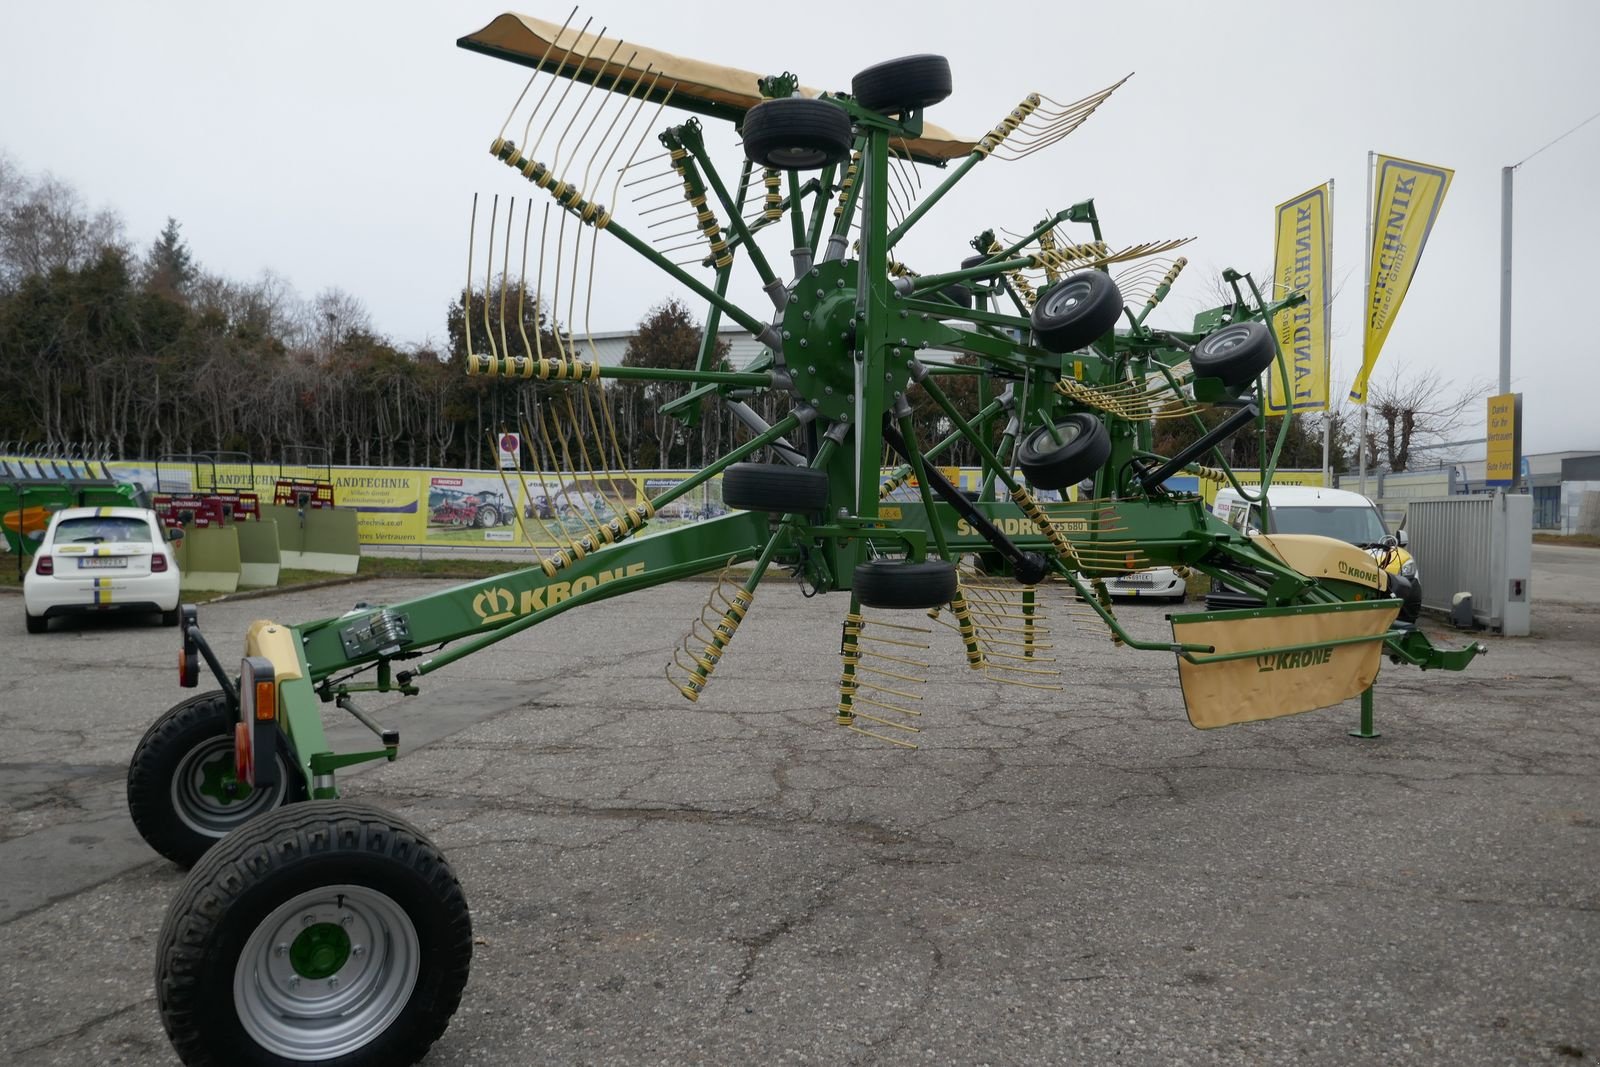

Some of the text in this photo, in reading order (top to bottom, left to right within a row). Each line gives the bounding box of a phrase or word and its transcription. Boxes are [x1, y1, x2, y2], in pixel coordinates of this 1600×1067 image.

[1375, 244, 1407, 330] Villach GmbH
[332, 476, 410, 488] ANDTECHNIK
[1067, 522, 1084, 531] 680
[1347, 566, 1378, 583] KRONE
[1275, 647, 1334, 671] KRONE
